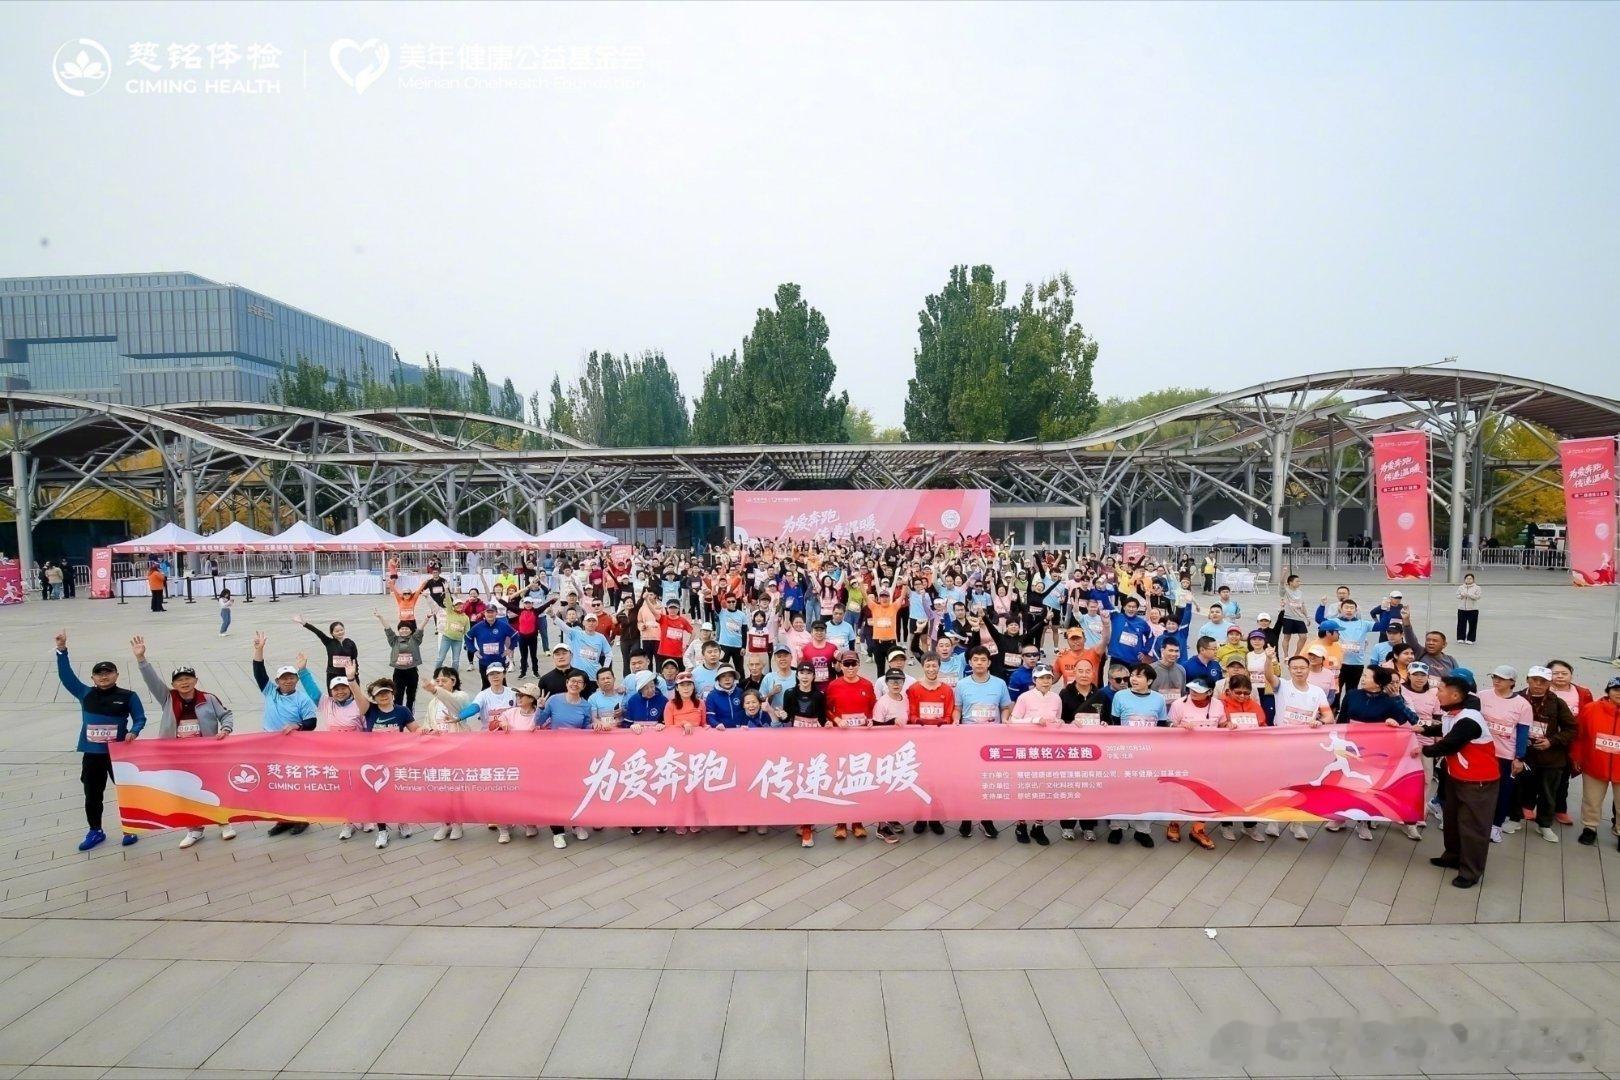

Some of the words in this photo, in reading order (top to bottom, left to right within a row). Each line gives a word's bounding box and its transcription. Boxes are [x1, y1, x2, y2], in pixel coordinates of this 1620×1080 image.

[778, 508, 840, 541] 为爱奔跑
[988, 746, 1094, 760] 第二届慈铭公益跑
[267, 763, 340, 780] 慈铭体检
[394, 766, 520, 782] 美年健康公益基金会
[747, 740, 933, 806] 传递温暖
[268, 781, 301, 791] CIMING
[304, 782, 340, 792] HEALTH
[427, 783, 470, 792] Onehealth
[472, 782, 520, 792] Foundation
[570, 745, 738, 822] 为爱奔跑
